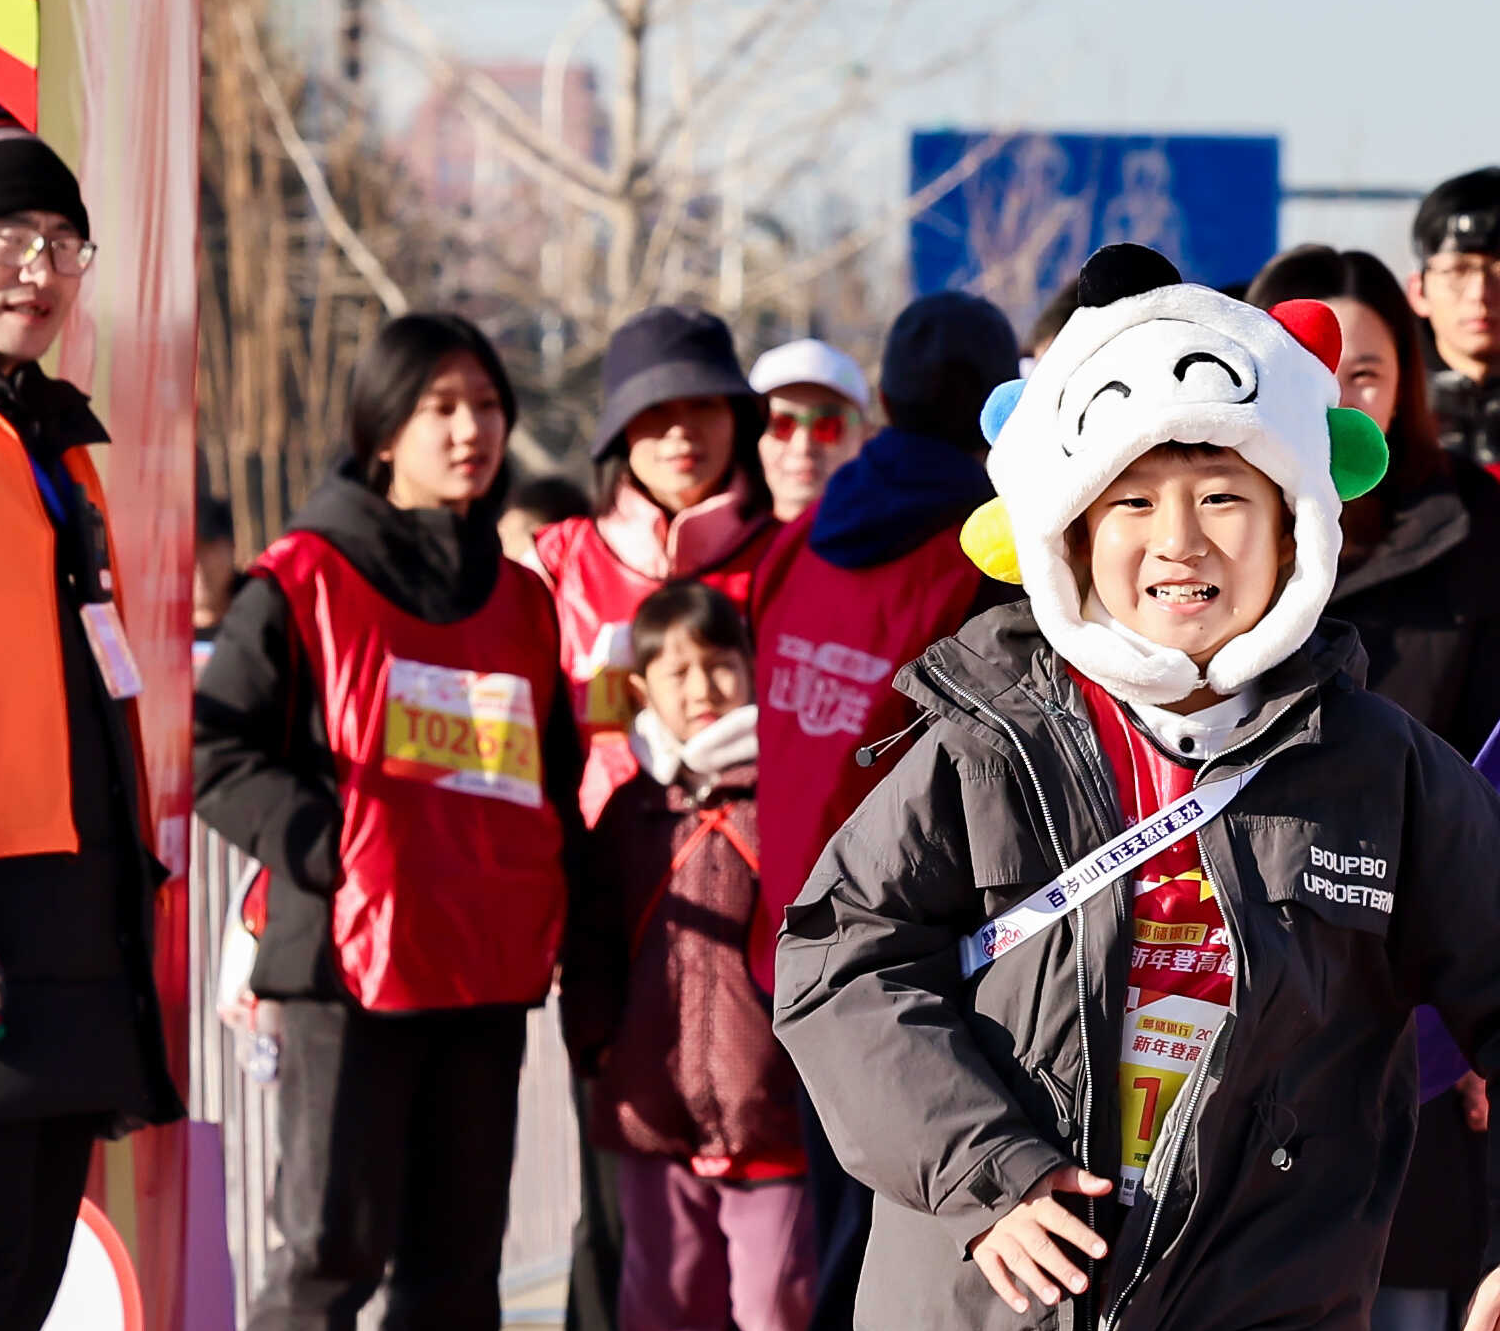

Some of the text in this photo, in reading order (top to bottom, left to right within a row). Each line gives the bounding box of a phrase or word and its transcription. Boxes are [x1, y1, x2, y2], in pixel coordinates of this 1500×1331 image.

[1046, 801, 1203, 908] 百岁山 真正天然矿泉水
